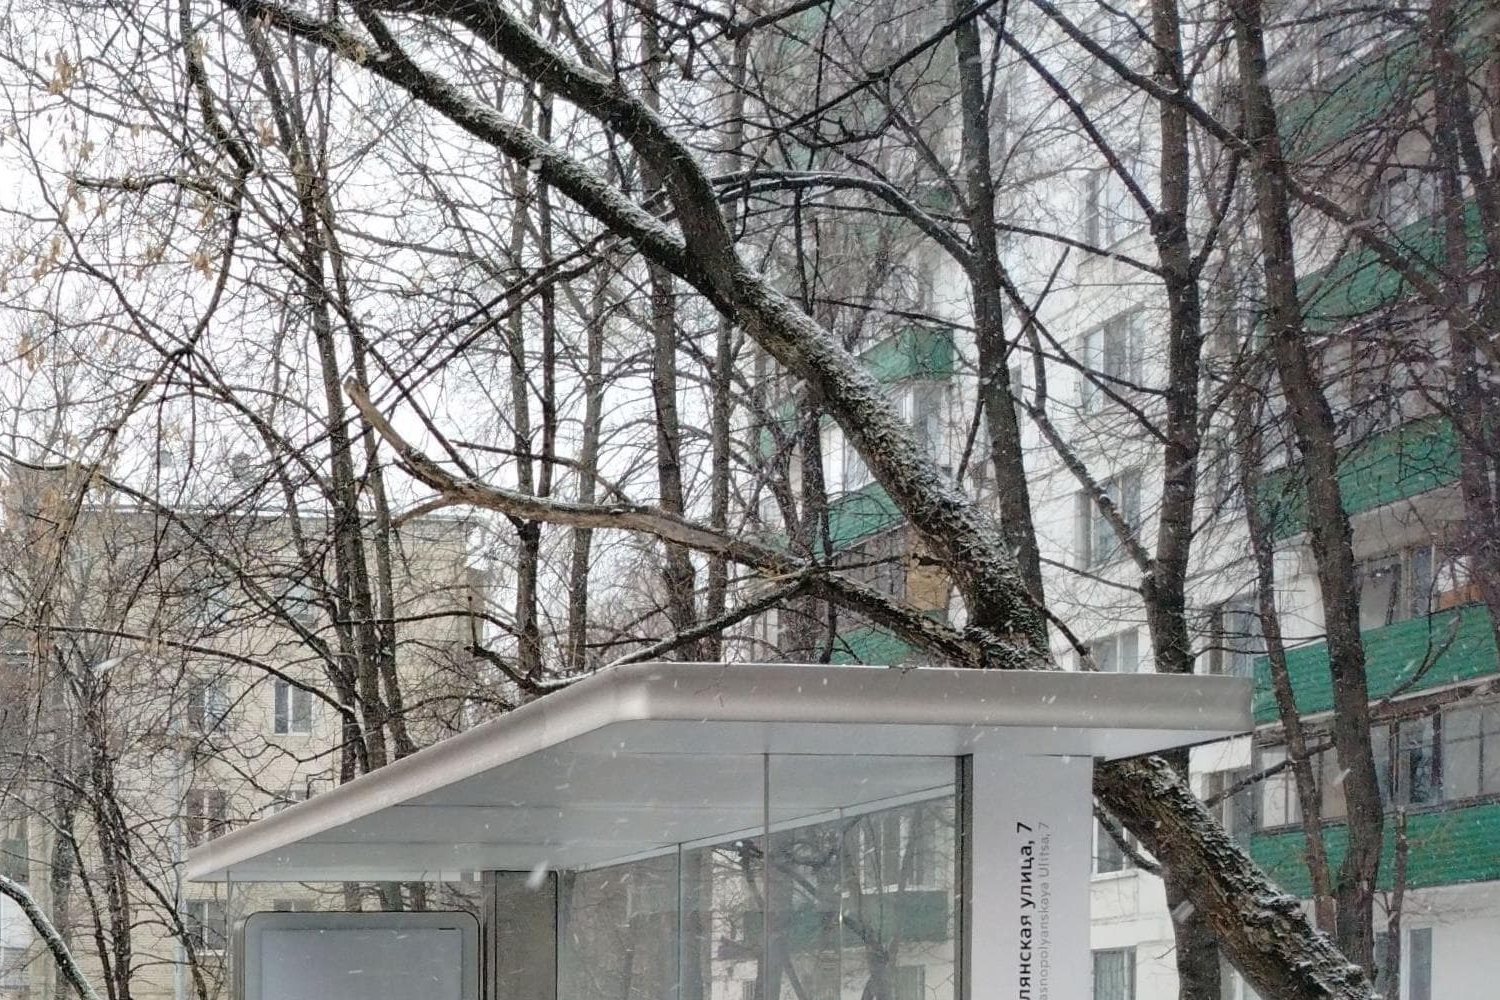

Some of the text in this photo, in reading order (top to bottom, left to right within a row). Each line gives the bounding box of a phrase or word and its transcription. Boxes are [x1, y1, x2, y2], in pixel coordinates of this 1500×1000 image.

[1016, 821, 1033, 834] 7
[1038, 821, 1050, 831] 7
[1037, 833, 1052, 878] Ulitsa,
[1019, 840, 1036, 909] улица,
